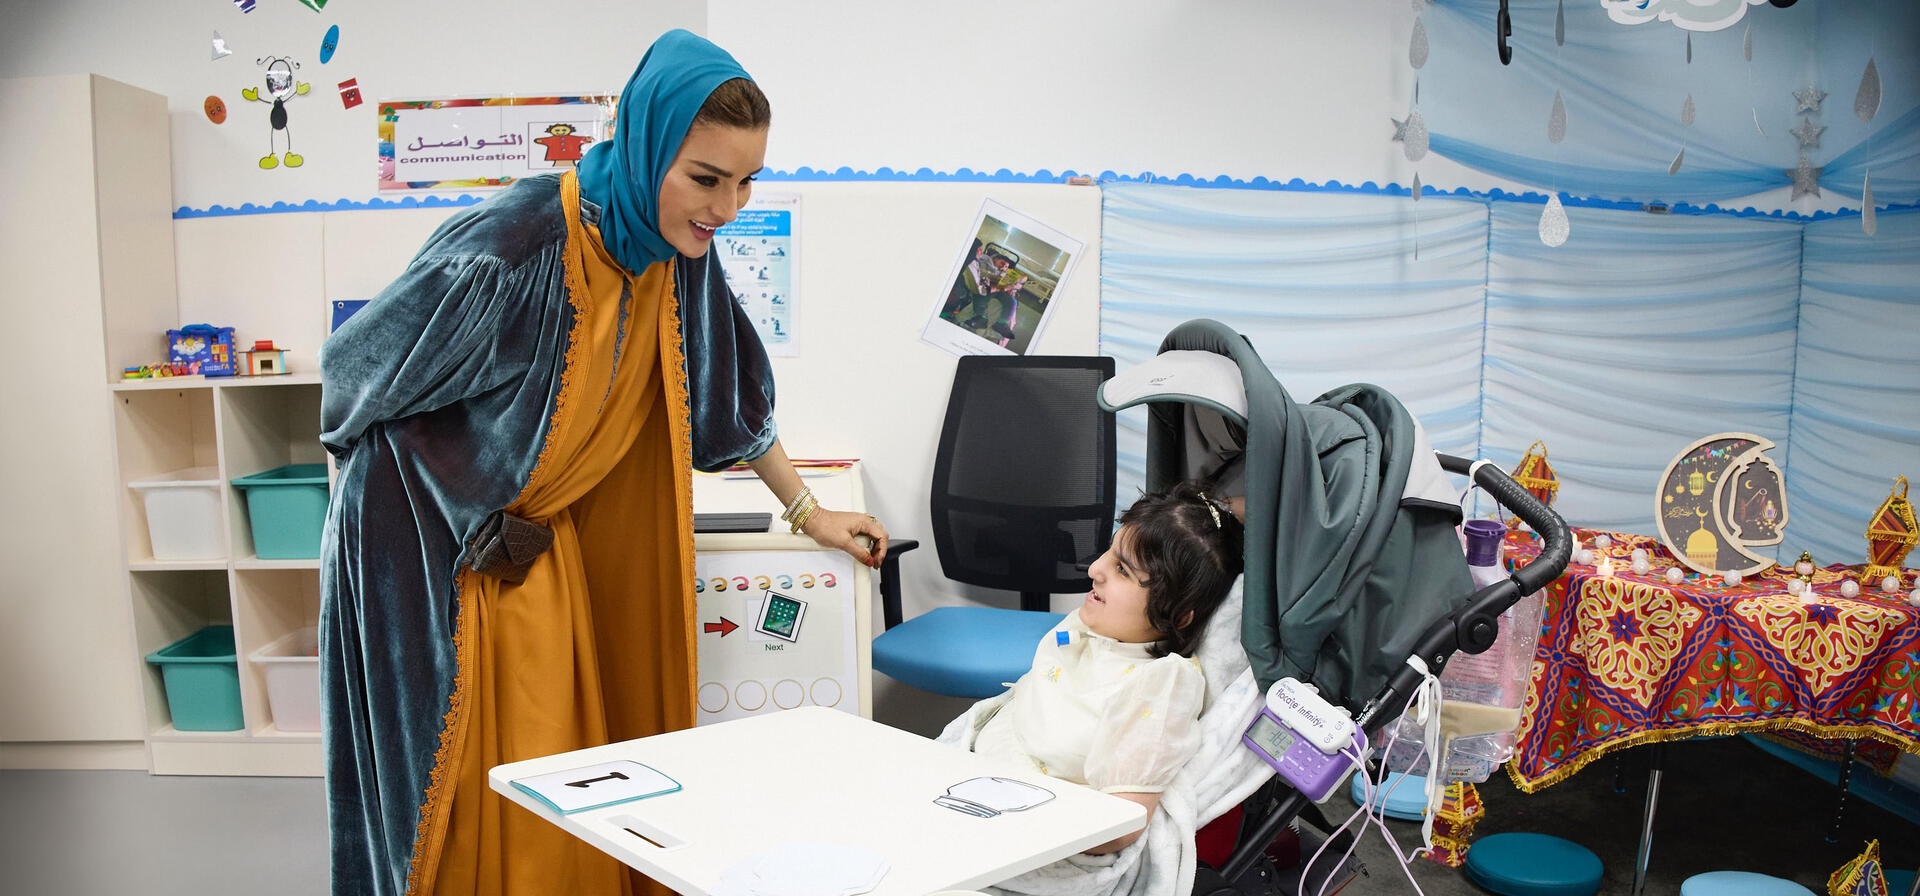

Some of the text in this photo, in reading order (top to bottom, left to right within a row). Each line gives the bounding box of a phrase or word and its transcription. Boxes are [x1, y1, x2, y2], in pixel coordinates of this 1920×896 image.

[407, 133, 523, 152] التواصل
[400, 153, 527, 164] communication
[564, 771, 630, 788] 1
